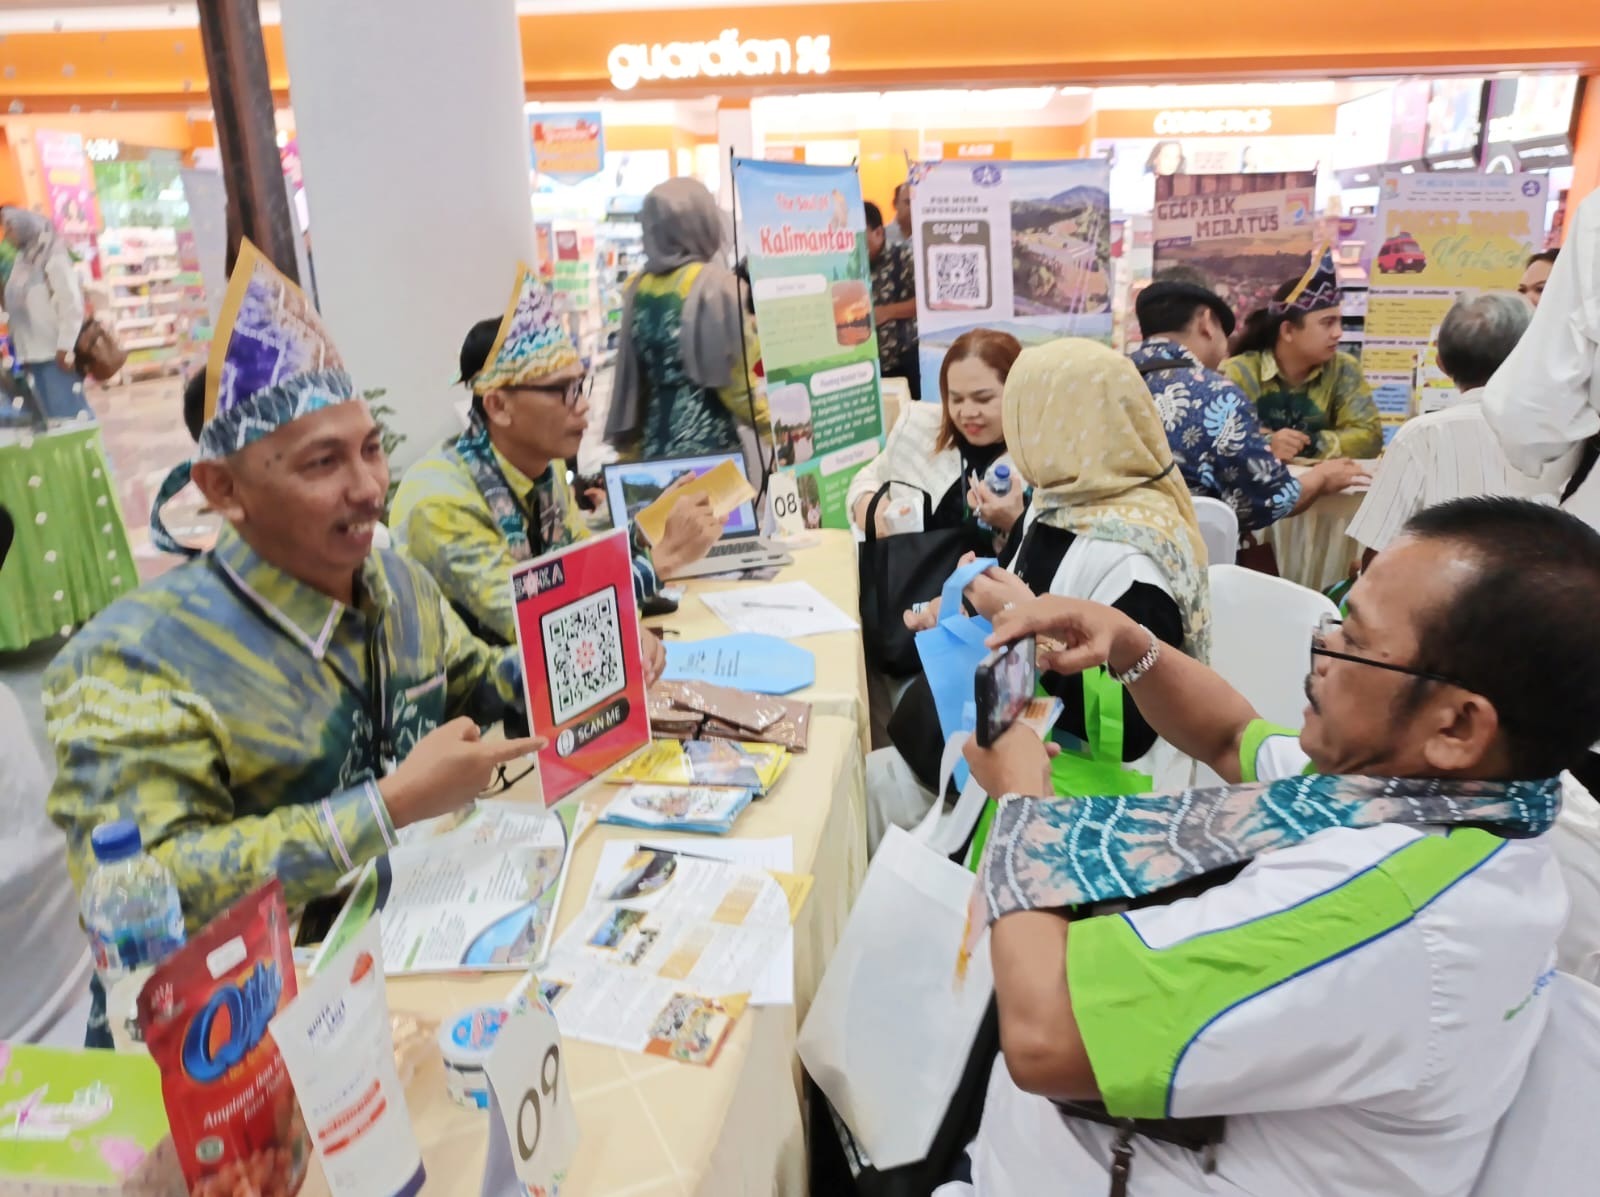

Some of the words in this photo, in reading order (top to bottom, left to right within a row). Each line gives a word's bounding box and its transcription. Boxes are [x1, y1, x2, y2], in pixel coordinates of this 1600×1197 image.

[607, 28, 791, 90] guardian
[921, 206, 989, 215] INFORMATION
[1156, 197, 1236, 221] GEOPARK
[759, 222, 855, 256] Kalimantan
[932, 223, 963, 235] SCAN
[1195, 213, 1279, 238] MERATUS
[774, 491, 798, 518] 08
[577, 716, 604, 741] SCAN
[606, 704, 621, 723] ME
[516, 1043, 560, 1162] 09
